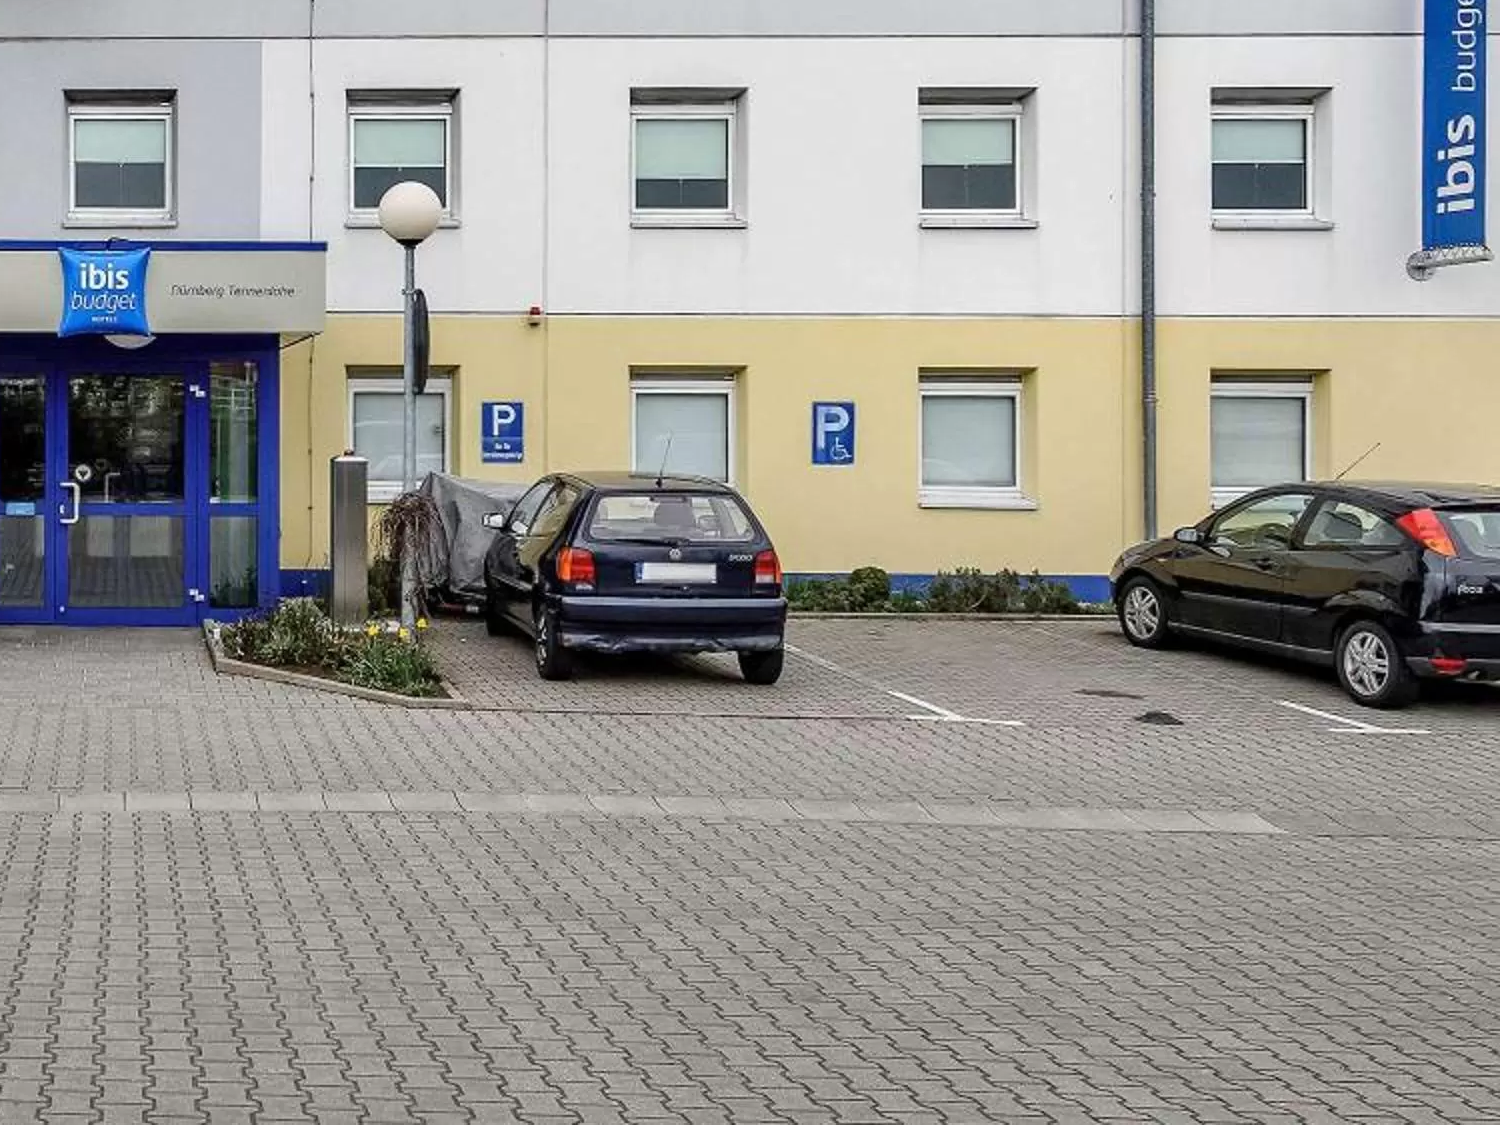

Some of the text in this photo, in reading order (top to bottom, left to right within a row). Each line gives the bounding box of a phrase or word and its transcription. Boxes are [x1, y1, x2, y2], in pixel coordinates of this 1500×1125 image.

[1436, 114, 1476, 214] ibis
[79, 262, 129, 290] ibis
[71, 290, 137, 314] budget
[493, 405, 516, 435] P
[816, 406, 849, 449] P
